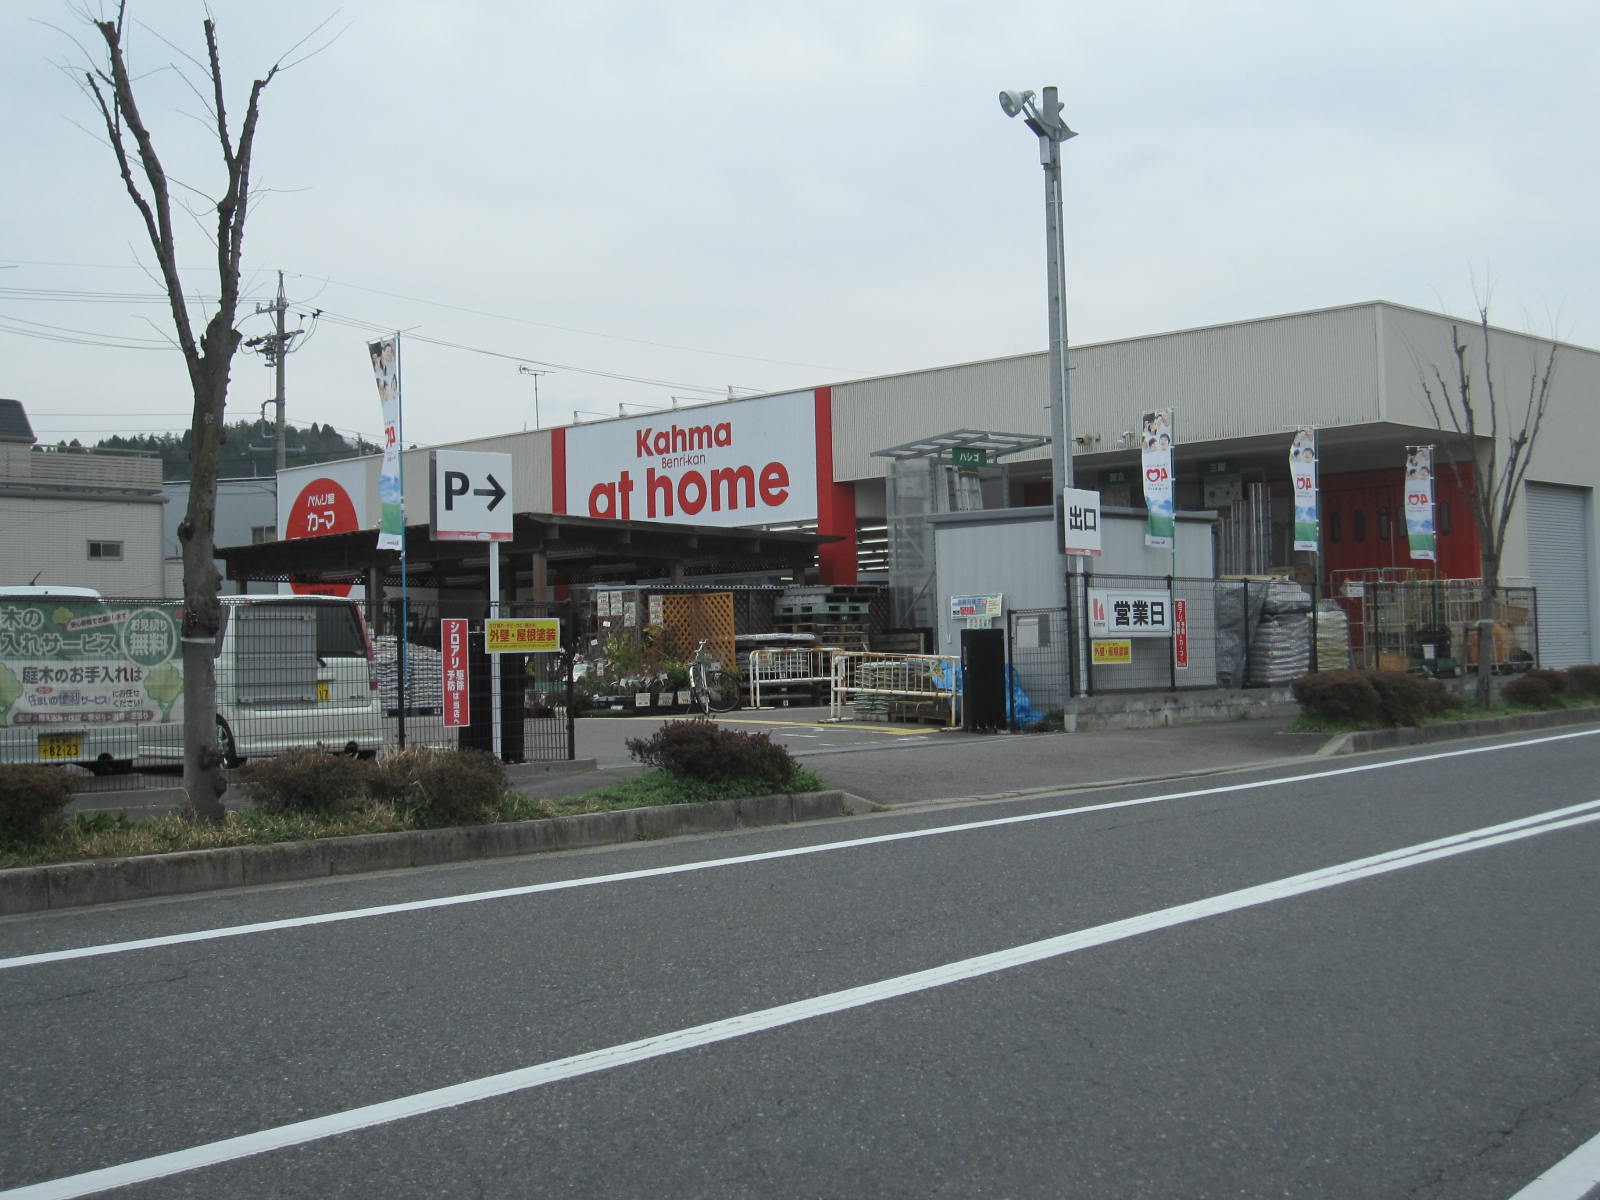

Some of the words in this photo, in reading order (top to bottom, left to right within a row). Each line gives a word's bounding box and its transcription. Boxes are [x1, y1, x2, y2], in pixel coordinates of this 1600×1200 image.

[636, 422, 732, 458] Kahma
[661, 454, 706, 469] Benri-kan
[444, 470, 470, 511] P
[588, 470, 634, 521] at
[646, 461, 790, 519] home
[307, 510, 336, 532] カーマ
[1069, 505, 1097, 532] 出口
[0, 606, 44, 630] 木の
[130, 618, 168, 632] お見積り
[1114, 600, 1165, 626] 営業日
[0, 632, 119, 656] 入れサービス
[130, 633, 168, 656] 無料
[450, 621, 460, 669] シロアリ
[489, 627, 557, 643] 外壁・屋根塗装
[22, 666, 143, 684] 庭木のお手入れは
